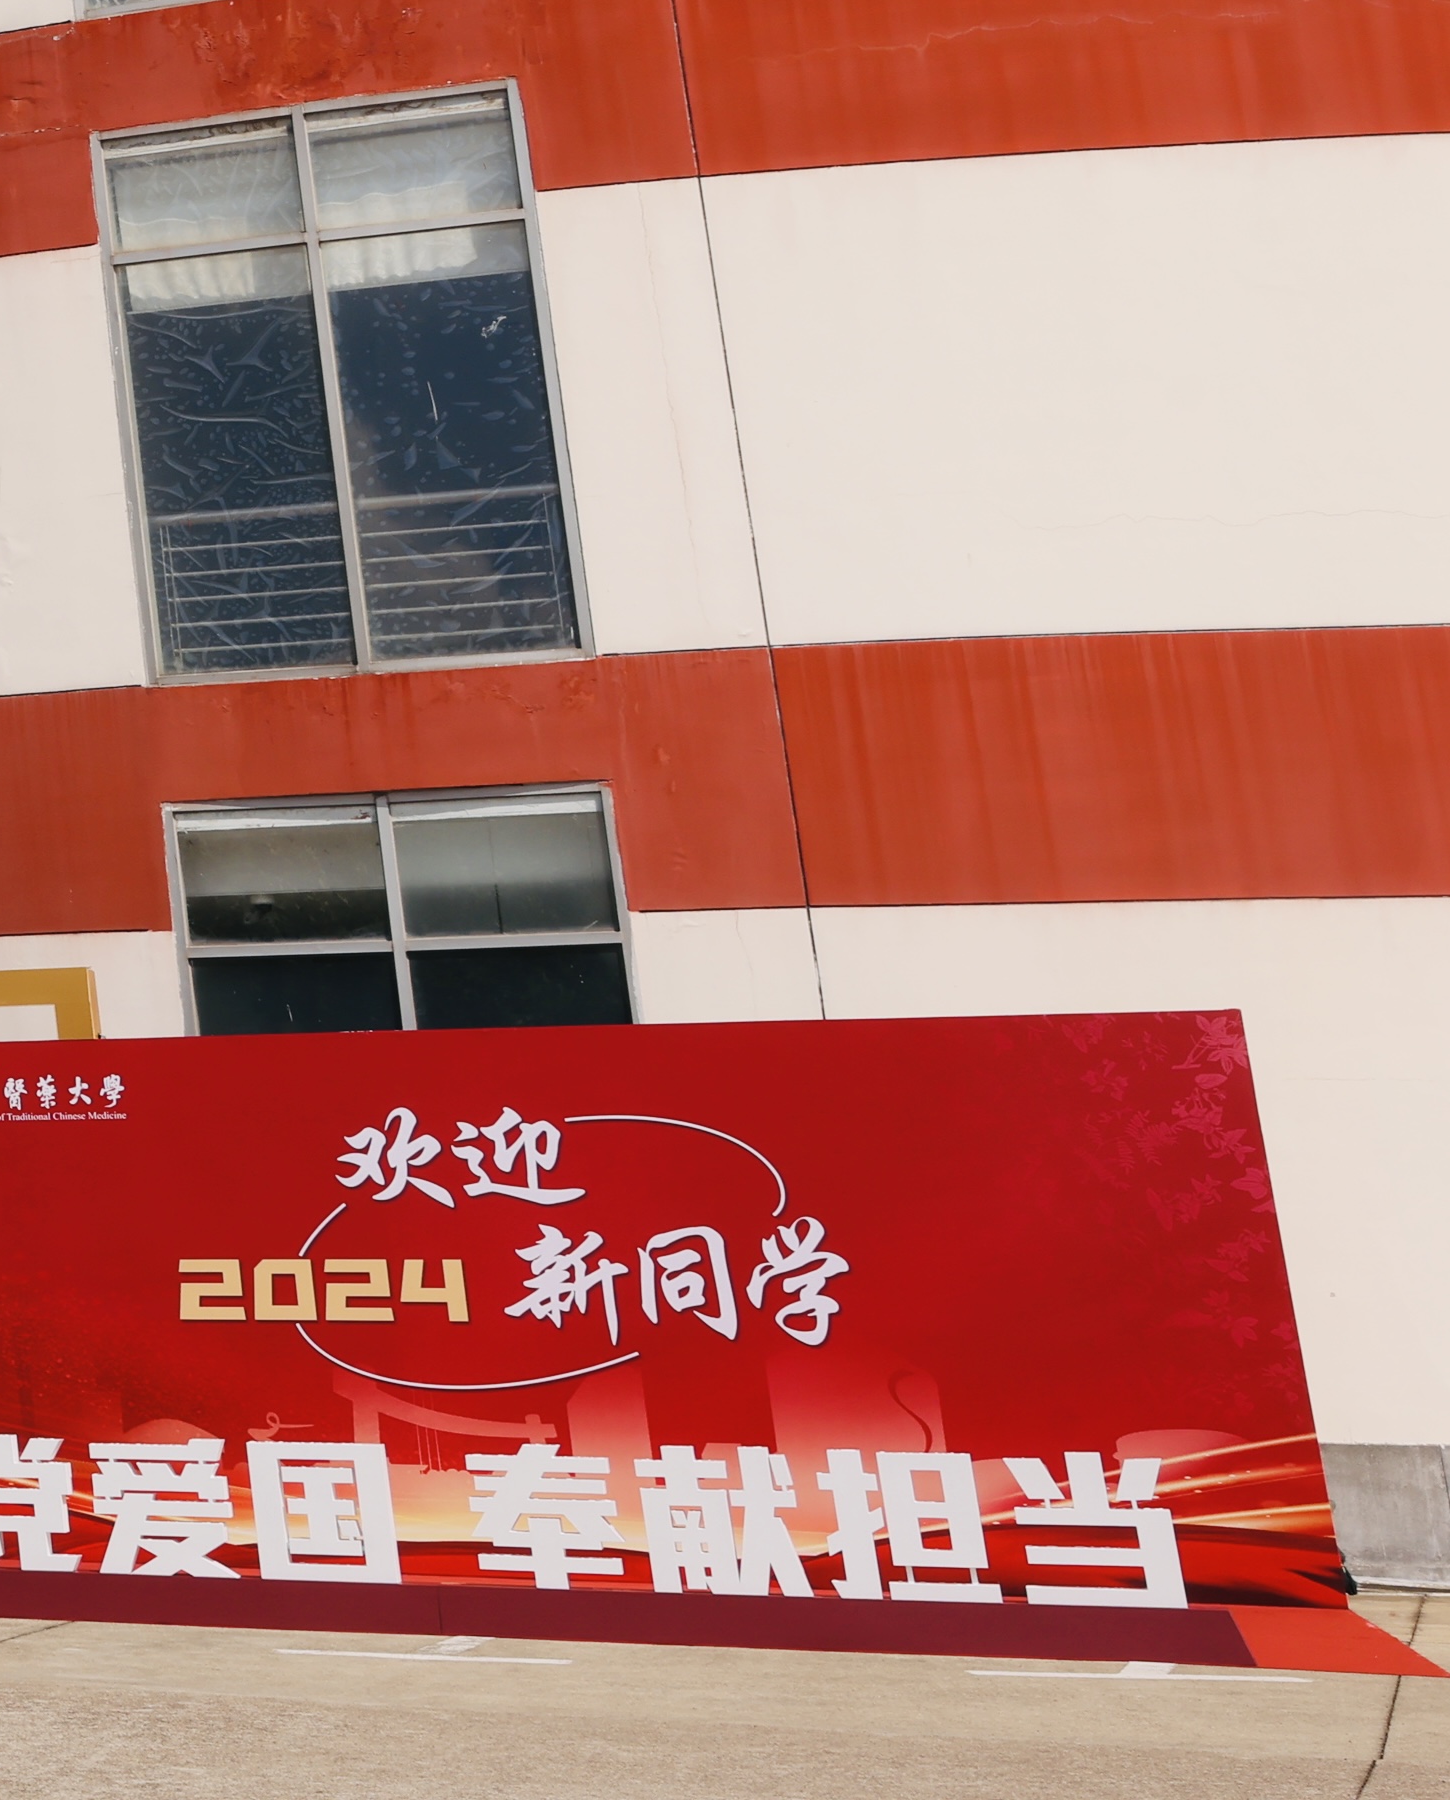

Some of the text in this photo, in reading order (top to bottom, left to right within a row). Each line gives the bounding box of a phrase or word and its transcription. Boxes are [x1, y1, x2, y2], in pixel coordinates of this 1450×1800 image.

[7, 1111, 51, 1122] Traditional
[52, 1111, 87, 1121] Chinese
[88, 1111, 128, 1121] Medicine
[335, 1106, 586, 1208] 欢迎
[178, 1216, 850, 1346] 2024 新同学
[465, 1443, 1190, 1610] 奉献担当
